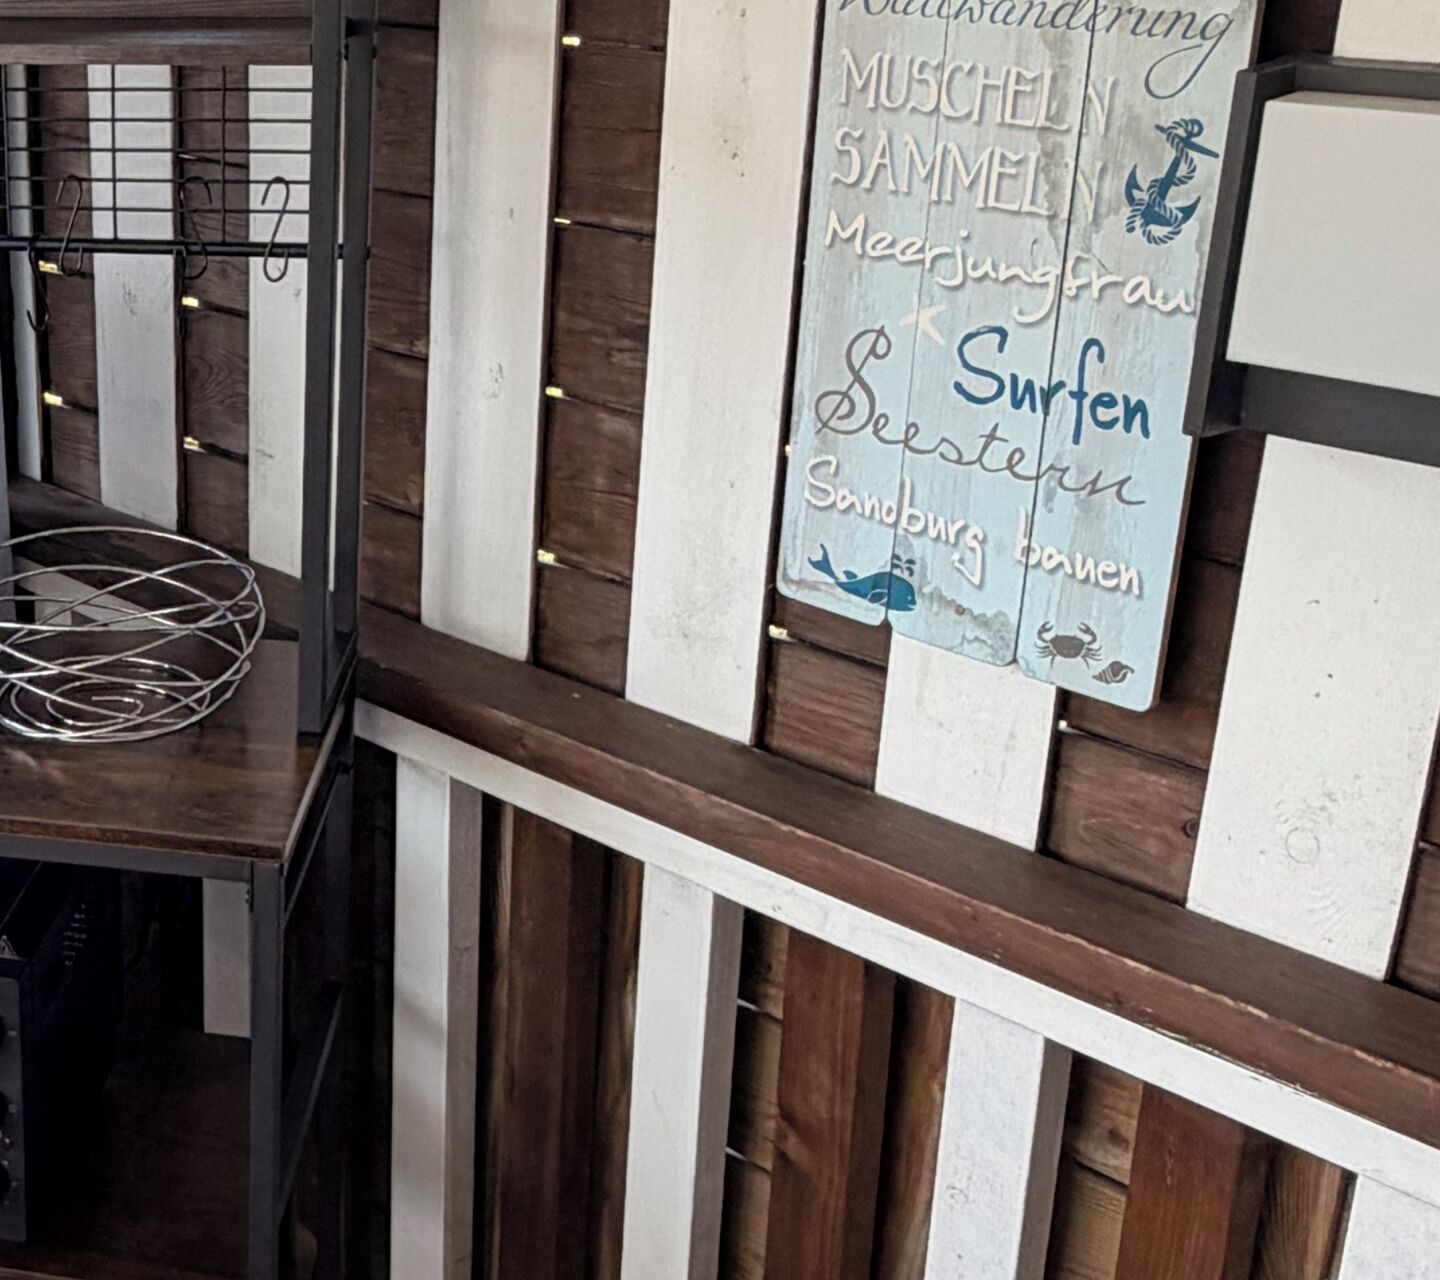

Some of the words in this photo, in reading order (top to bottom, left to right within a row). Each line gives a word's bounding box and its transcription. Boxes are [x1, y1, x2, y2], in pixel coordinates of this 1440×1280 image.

[838, 47, 1116, 137] MUSCHELN
[830, 128, 1104, 224] SAMMELN
[824, 210, 1194, 325] Meerjungfrau
[814, 325, 1147, 506] Seestern
[953, 325, 1151, 446] Surfen
[803, 455, 988, 589] Sandburg
[1016, 505, 1143, 597] bauen
